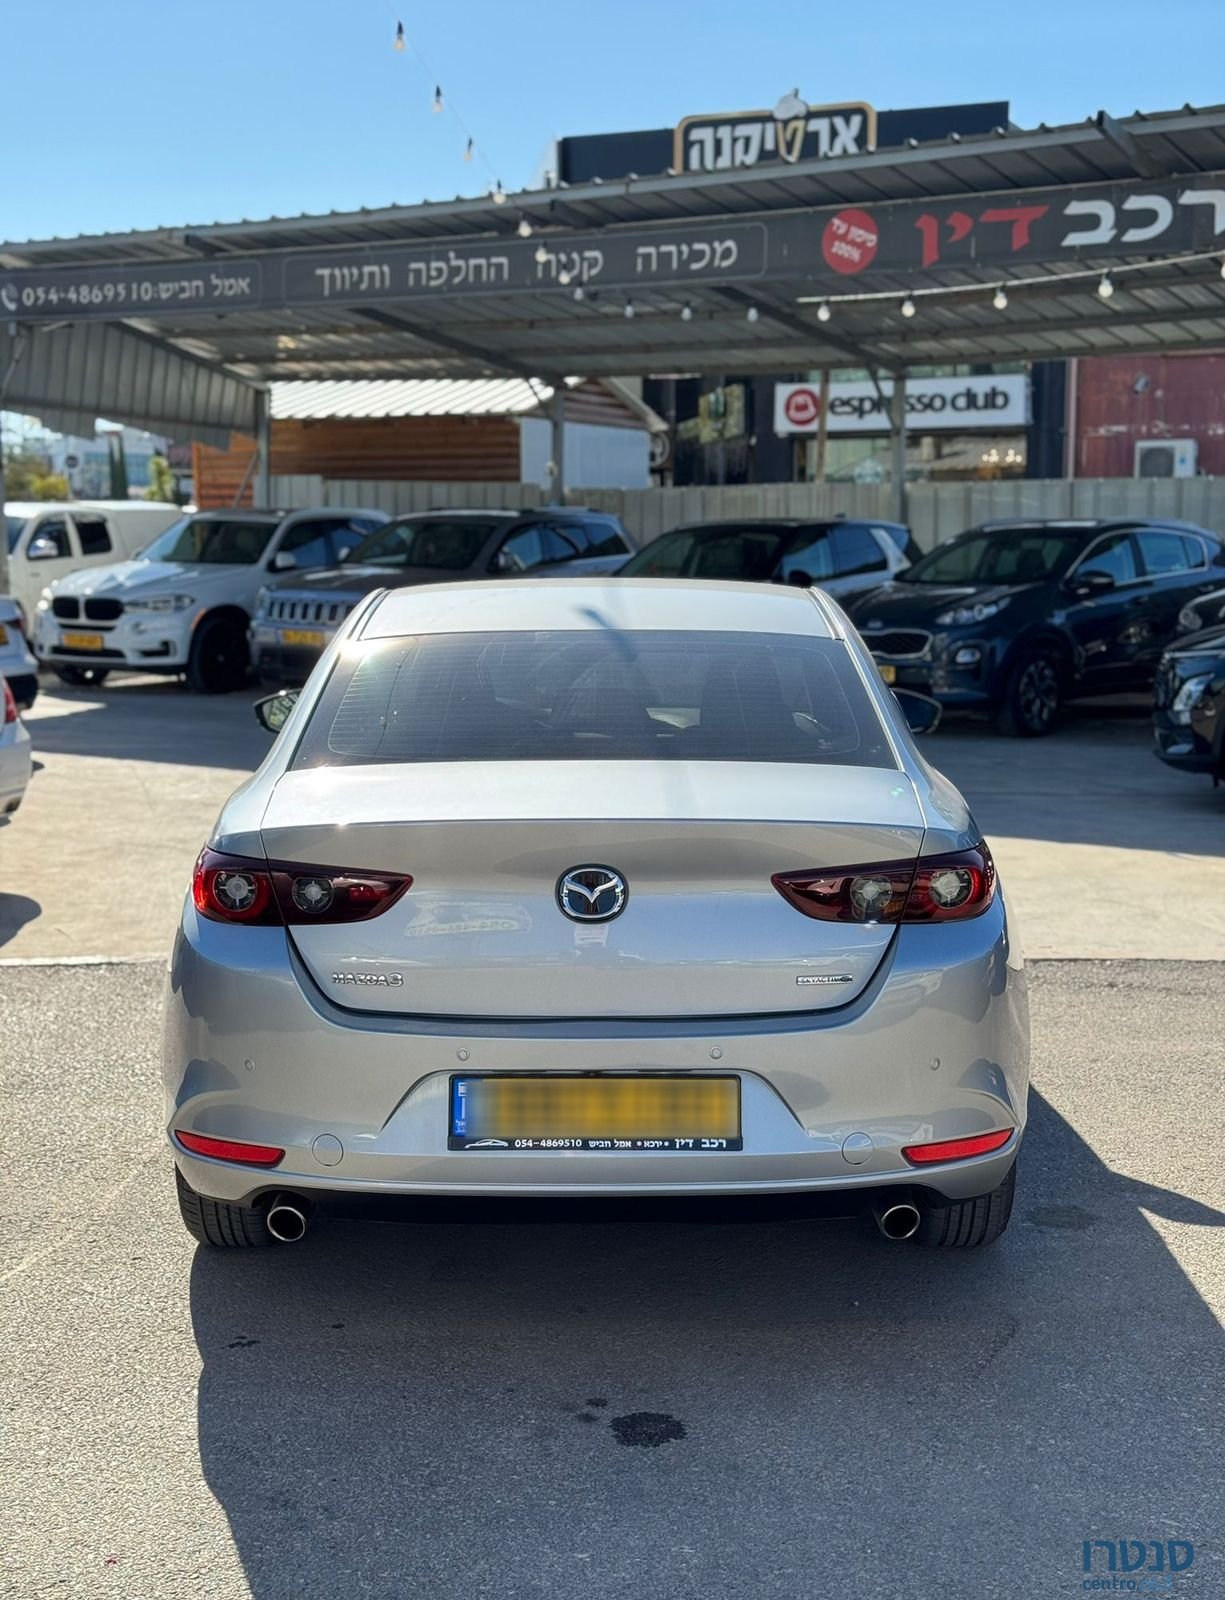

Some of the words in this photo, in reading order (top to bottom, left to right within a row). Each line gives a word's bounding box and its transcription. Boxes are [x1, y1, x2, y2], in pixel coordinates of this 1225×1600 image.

[914, 205, 1049, 269] דין
[636, 239, 738, 274] מכירה
[315, 264, 391, 297] ותיווך
[408, 251, 509, 288] החלפה
[210, 273, 251, 297] אמל
[951, 385, 1009, 412] club
[514, 1138, 582, 1148] 054-4869510
[588, 1140, 612, 1148] חביש
[613, 1138, 632, 1148] אמל
[674, 1138, 694, 1149] דין
[701, 1138, 727, 1149] רכב
